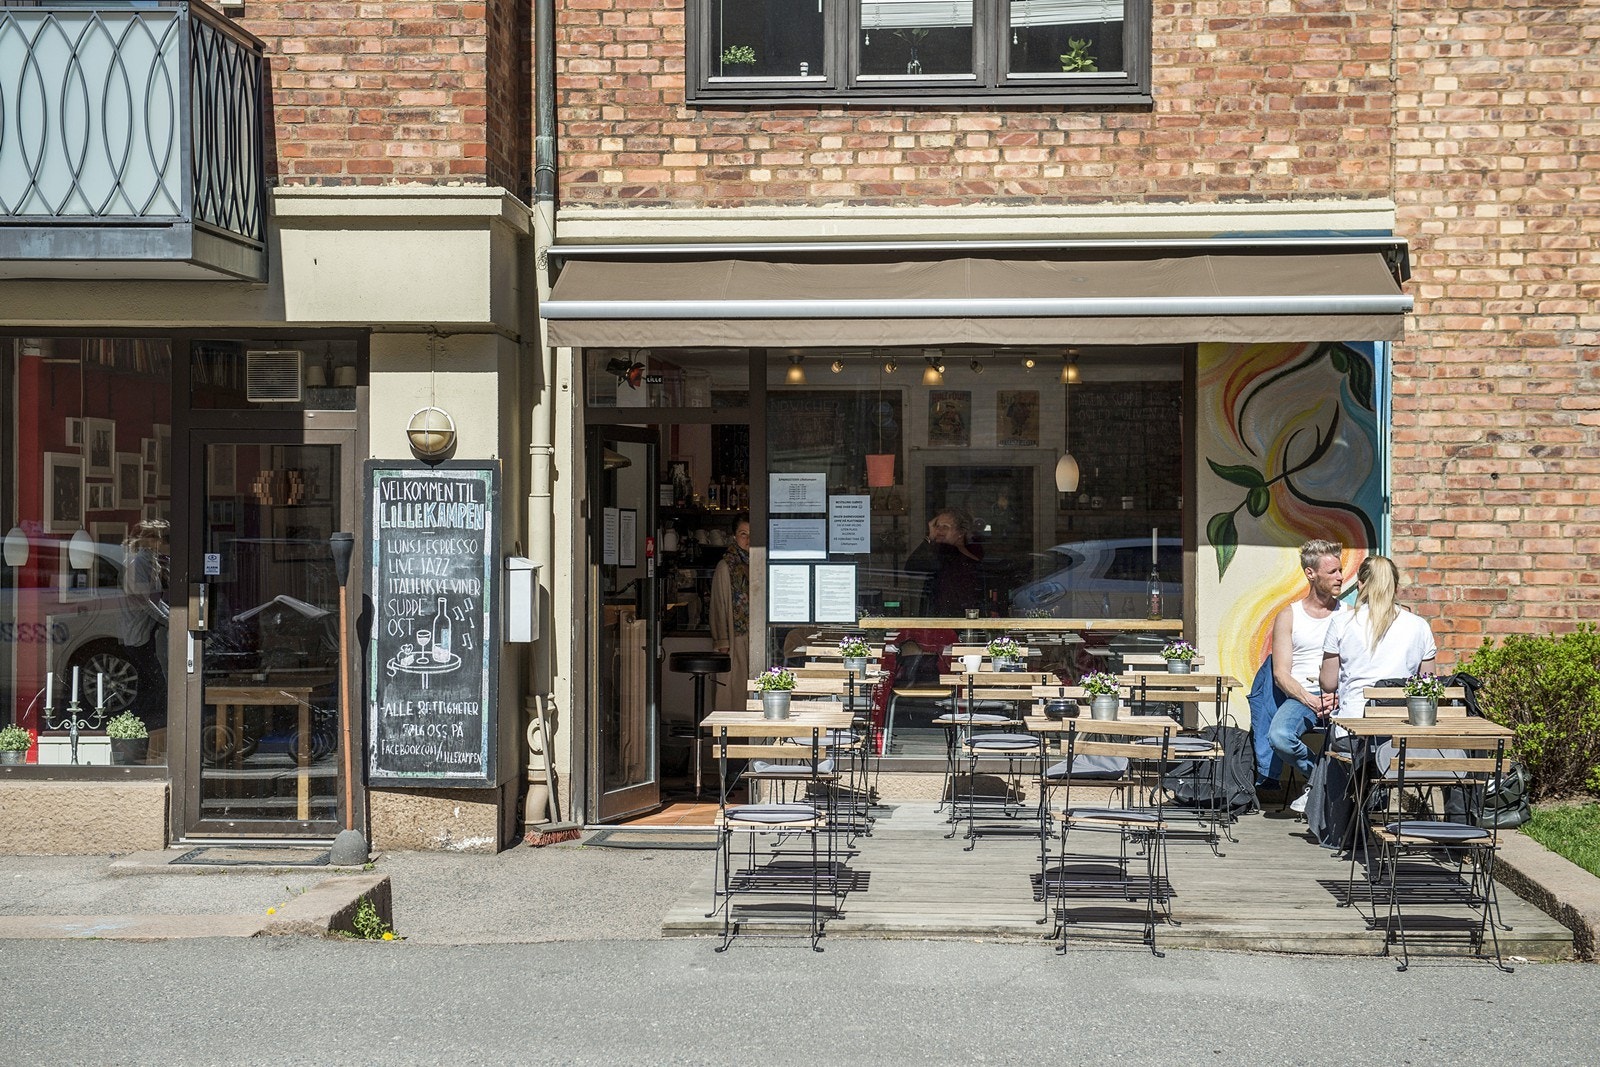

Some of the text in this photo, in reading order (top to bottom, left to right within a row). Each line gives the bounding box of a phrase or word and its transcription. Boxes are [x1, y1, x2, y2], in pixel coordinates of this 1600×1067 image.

[381, 480, 478, 503] VELKOMMEN TIL
[425, 538, 478, 555] ESPRESSO
[388, 558, 451, 576] LIVE JAZZ
[389, 577, 481, 596] ITALIENSKE VINER
[388, 598, 427, 616] SUPPE
[387, 618, 415, 638] OST
[417, 700, 479, 717] RETTIGHETER
[427, 723, 448, 738] OSS
[451, 721, 464, 738] PÅ
